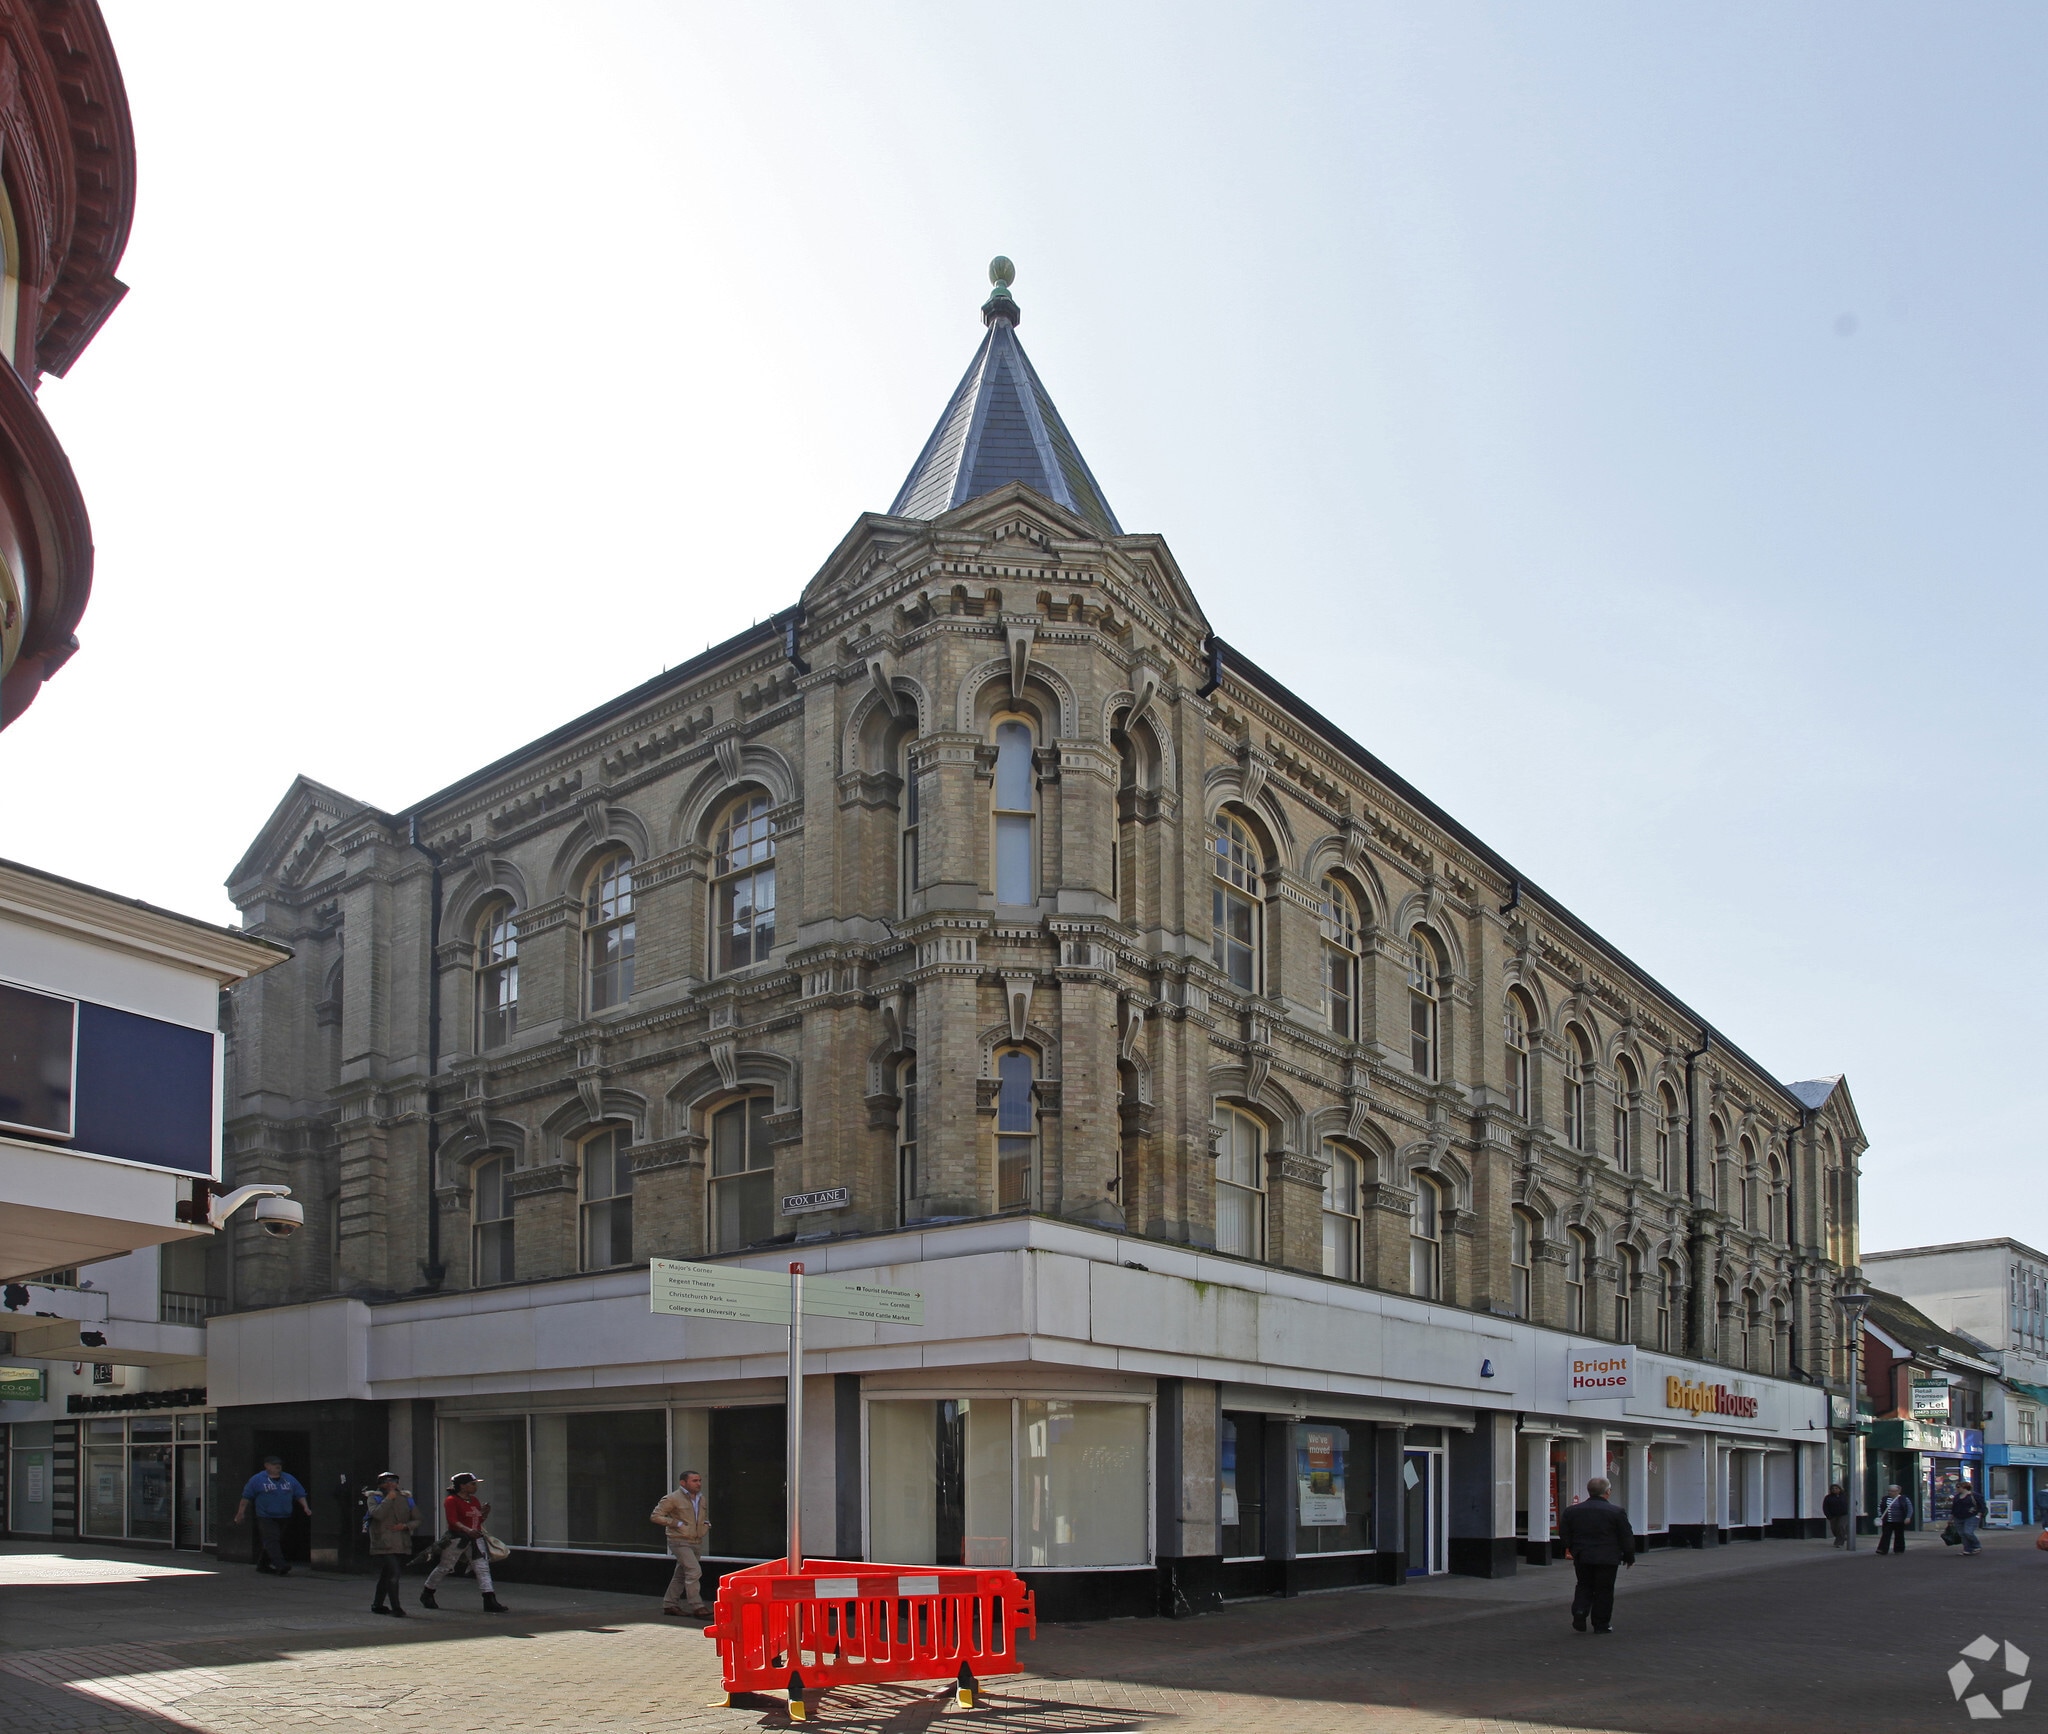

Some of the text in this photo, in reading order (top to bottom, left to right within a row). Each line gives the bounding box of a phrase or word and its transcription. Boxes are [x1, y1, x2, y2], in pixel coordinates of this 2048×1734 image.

[789, 1190, 840, 1207] COX LANE
[668, 1264, 713, 1274] Major's Corner
[668, 1277, 715, 1288] Regent Theatre
[668, 1290, 708, 1300] Christchurch
[709, 1294, 723, 1302] Park
[862, 1286, 880, 1294] Tourist
[880, 1289, 911, 1297] Information
[668, 1304, 692, 1313] College
[706, 1308, 737, 1317] University
[890, 1301, 911, 1309] Cornhill
[875, 1312, 891, 1320] Cattle
[1573, 1358, 1627, 1374] Bright
[1573, 1375, 1627, 1388] House
[1, 1384, 32, 1392] CO-OP
[1914, 1401, 1945, 1409] To Let
[1308, 1433, 1328, 1444] We've
